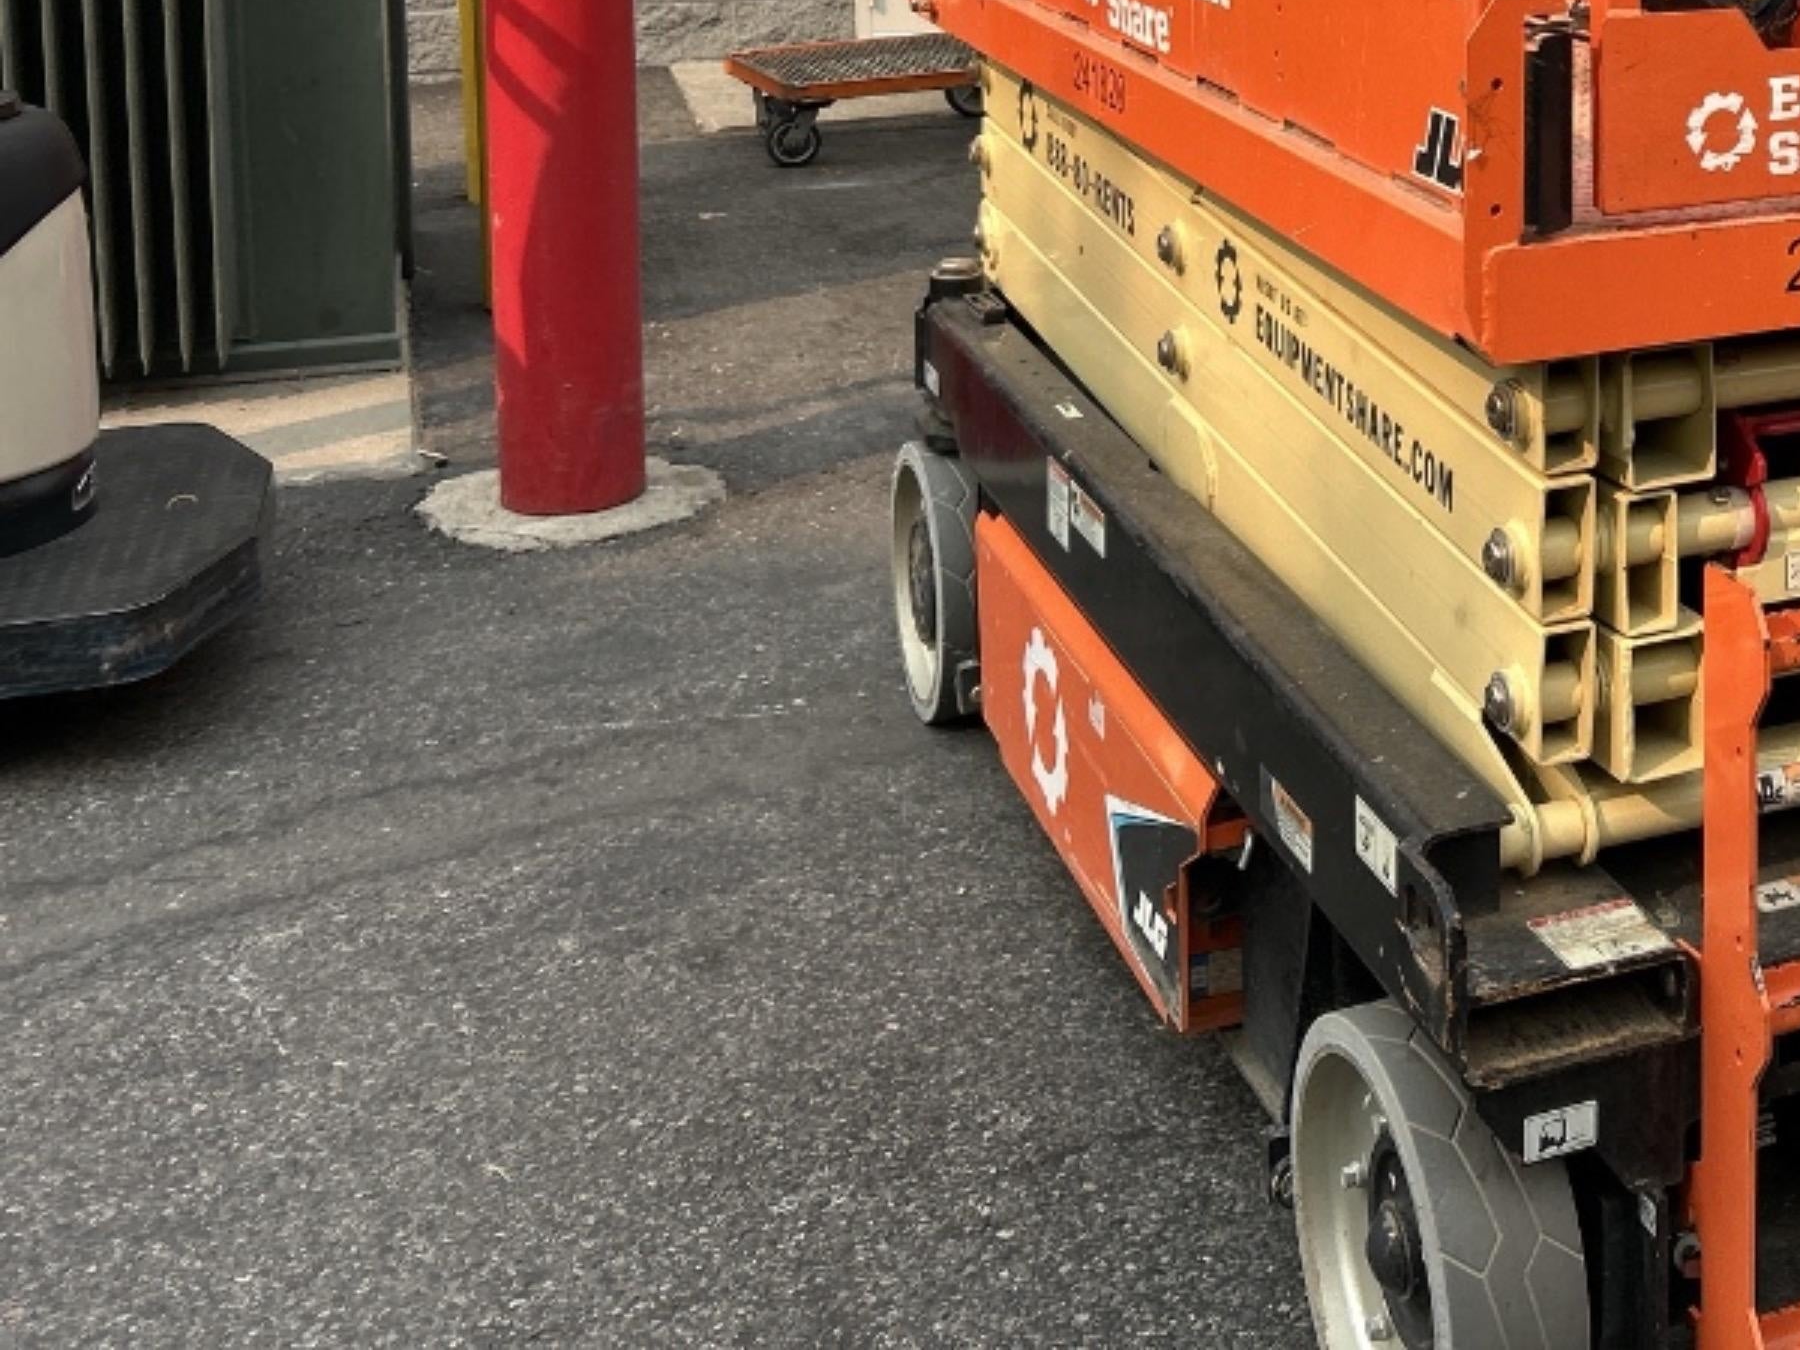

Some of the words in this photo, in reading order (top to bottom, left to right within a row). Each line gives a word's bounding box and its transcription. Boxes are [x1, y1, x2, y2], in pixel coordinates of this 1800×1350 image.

[1411, 107, 1464, 195] JL
[1255, 305, 1454, 514] EQUIPMENTSHARE.COM
[1133, 890, 1168, 961] JLG
